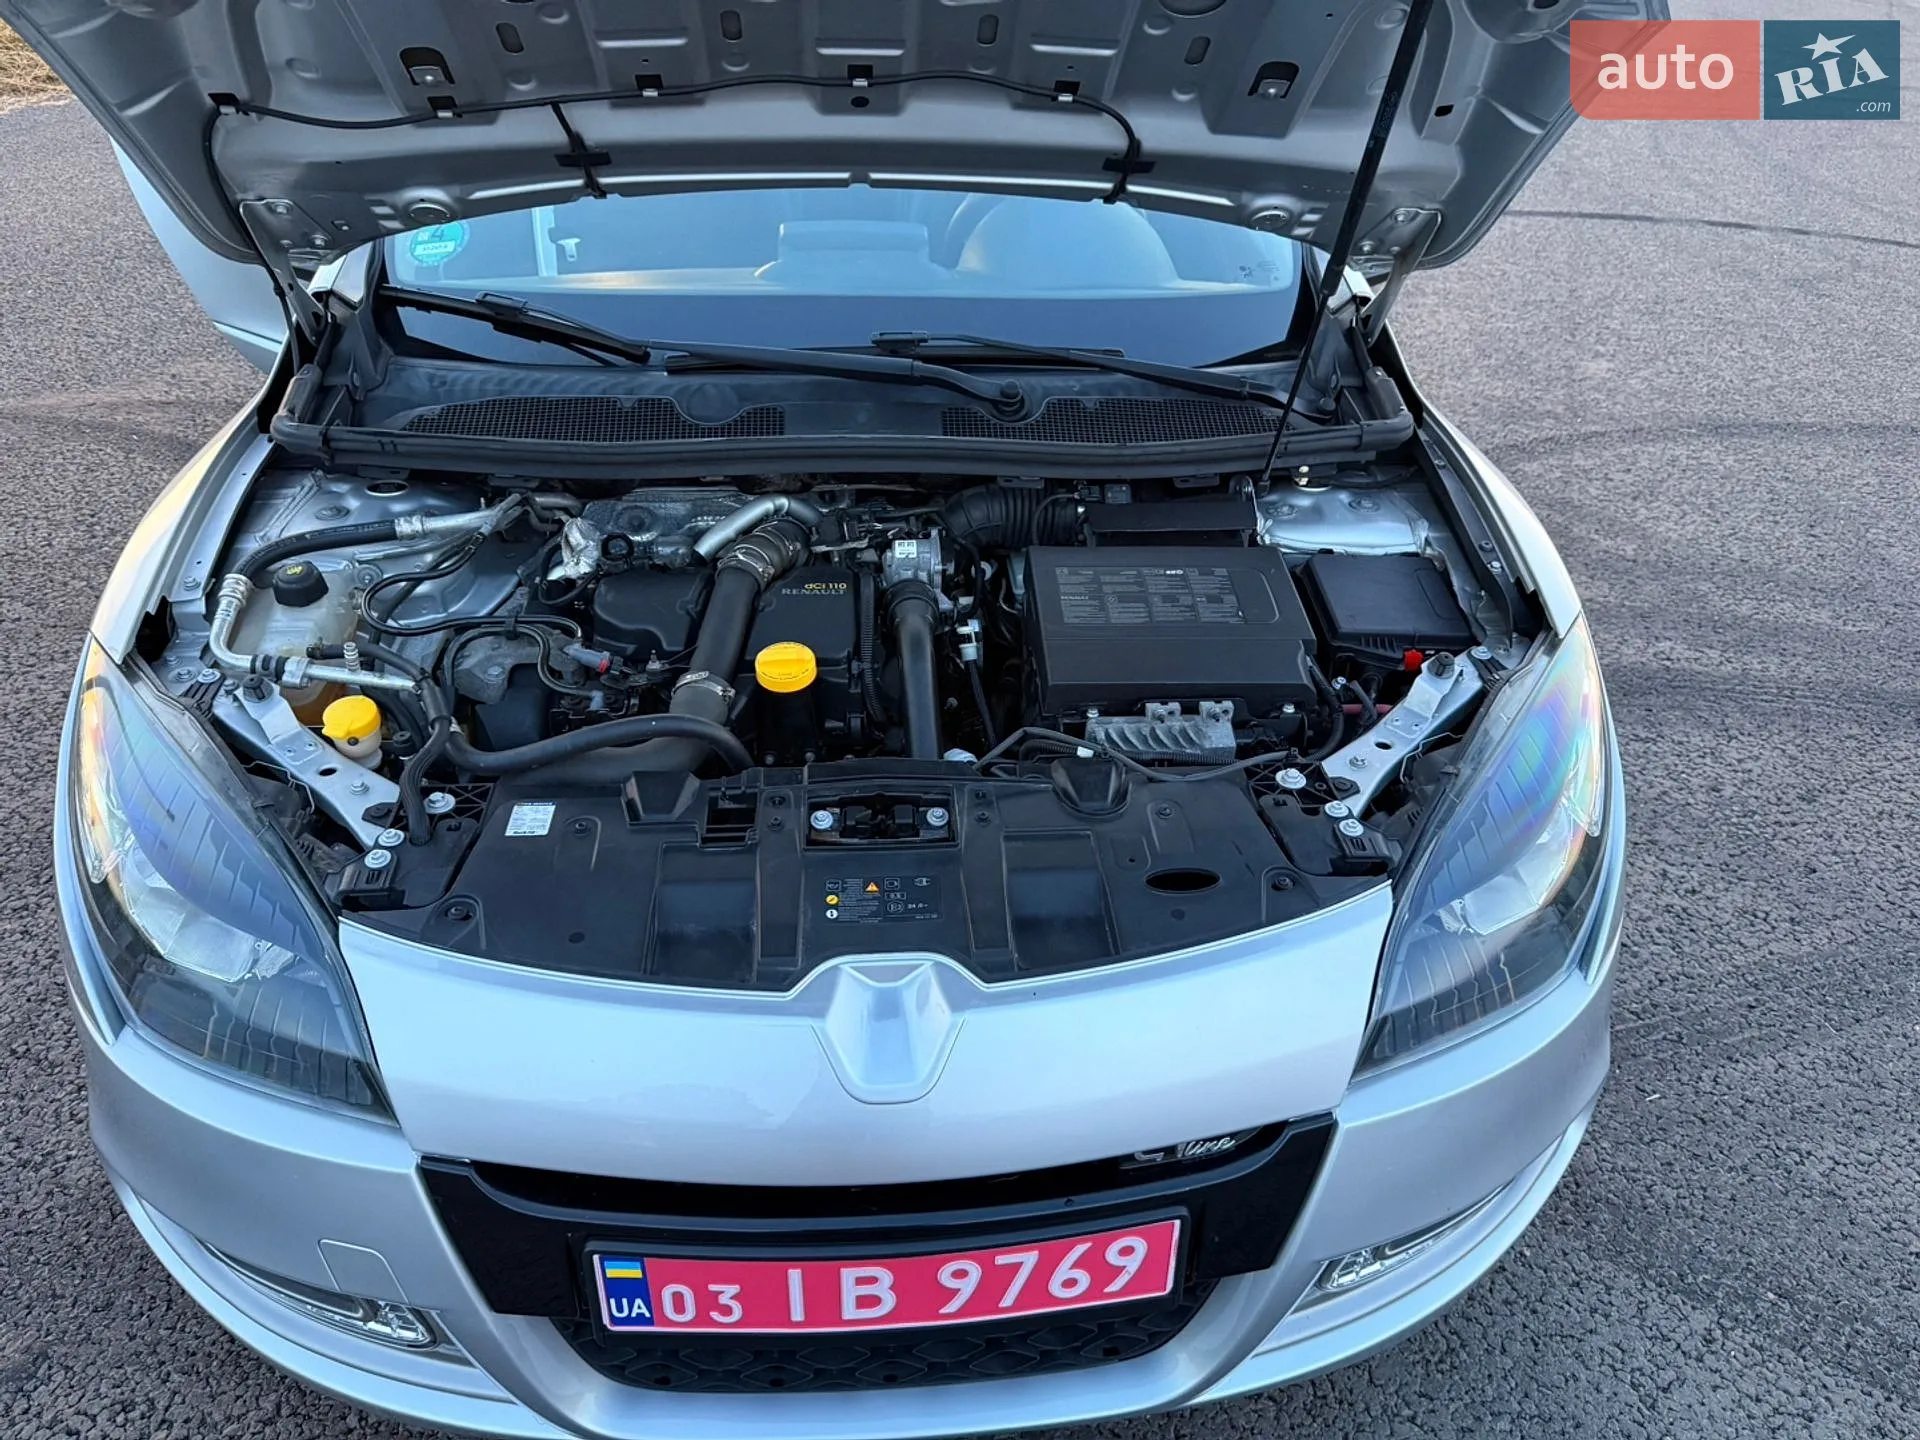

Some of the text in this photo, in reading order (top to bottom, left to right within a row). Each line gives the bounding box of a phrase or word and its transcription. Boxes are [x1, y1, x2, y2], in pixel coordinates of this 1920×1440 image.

[781, 588, 846, 596] RENAULT
[660, 1236, 1149, 1324] 03 IB 9769
[609, 1297, 651, 1319] UA
